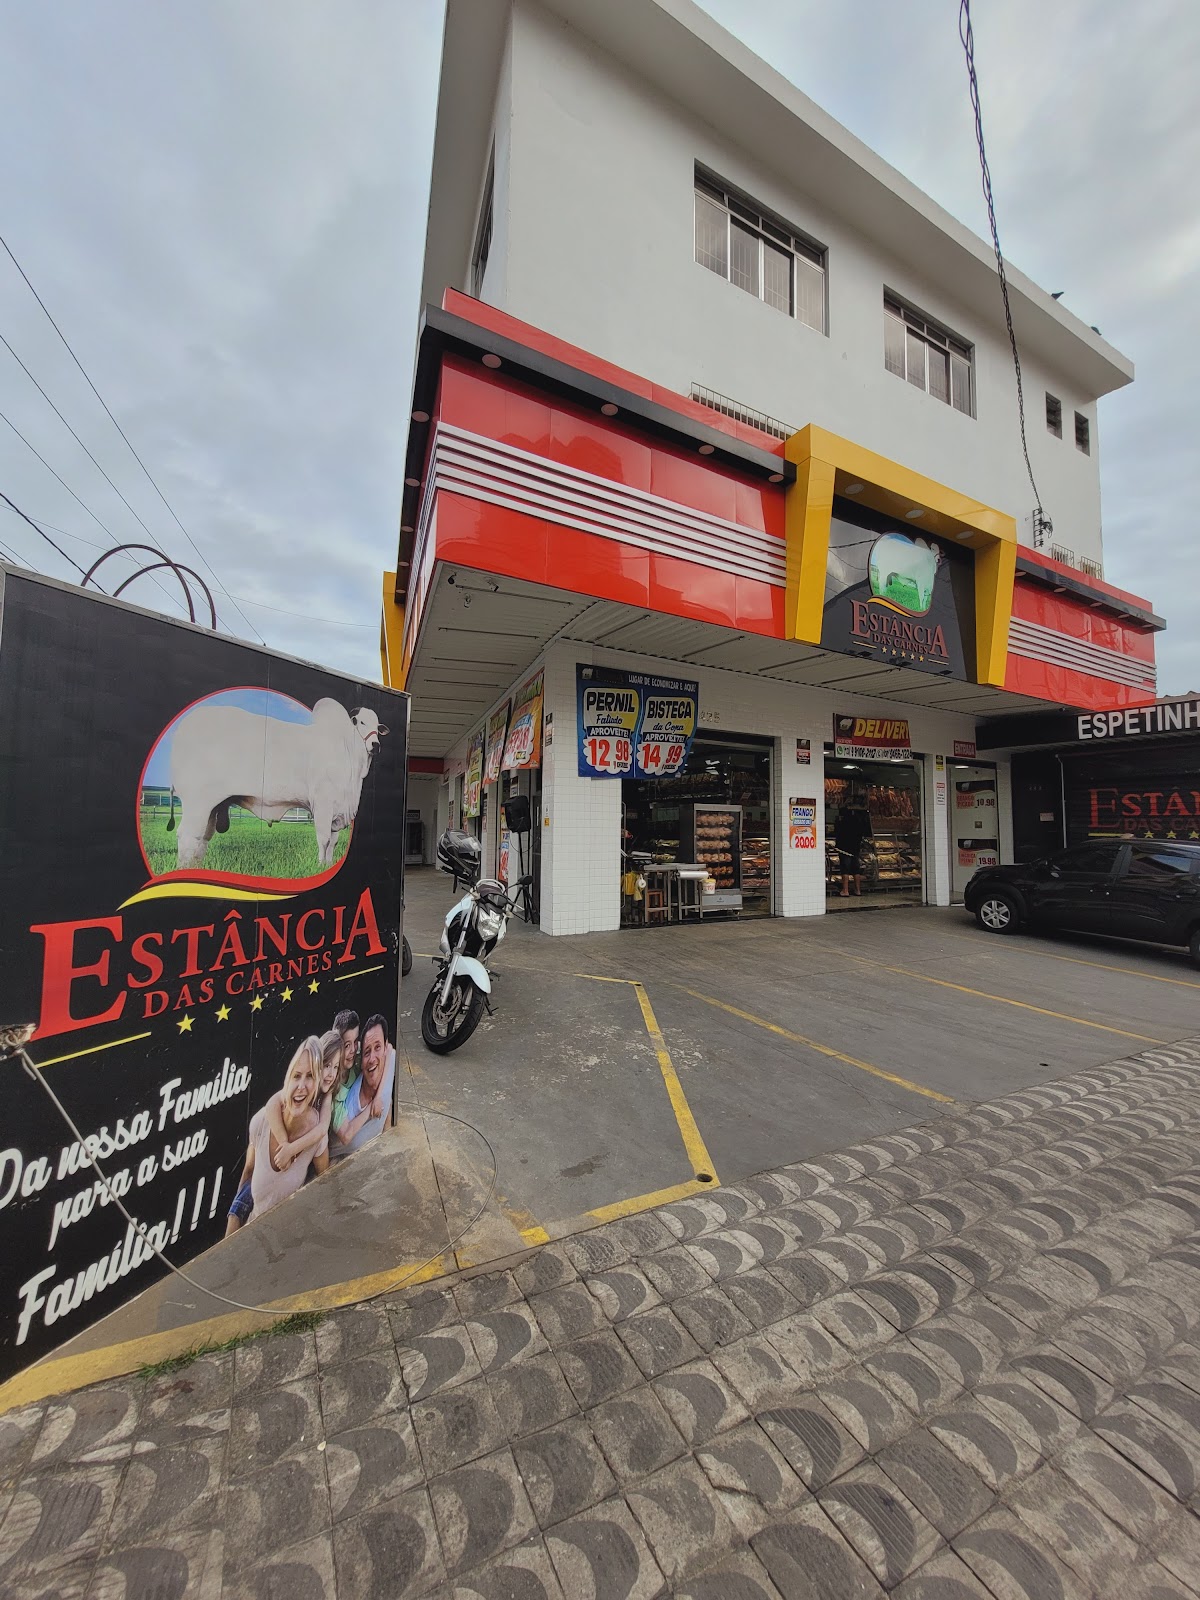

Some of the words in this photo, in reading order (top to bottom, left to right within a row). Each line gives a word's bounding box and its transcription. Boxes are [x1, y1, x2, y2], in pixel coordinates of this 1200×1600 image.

[849, 599, 949, 658] ESTÂNCIA
[873, 633, 892, 646] DAS
[894, 638, 929, 654] CARNES
[628, 674, 643, 685] LUGAR
[644, 677, 651, 686] DE
[651, 678, 679, 690] ECONOMIZAR
[586, 691, 635, 712] PERNIL
[647, 700, 692, 719] BISTECA
[596, 714, 623, 725] Fatiado
[653, 722, 663, 731] da
[664, 722, 684, 734] Copa
[1077, 701, 1200, 739] ESPETINH
[590, 727, 628, 738] APROVEITE!
[645, 733, 685, 743] APROVEITE!
[792, 807, 814, 817] FRANGO
[1123, 818, 1163, 831] DAS
[29, 887, 388, 1041] ESTÂNCIA
[143, 978, 214, 1019] DAS
[226, 950, 333, 995] CARNES
[0, 1148, 52, 1209] Da
[56, 1110, 154, 1186] nossa
[158, 1057, 253, 1132] Família
[47, 1167, 132, 1251] para
[137, 1155, 158, 1188] a
[161, 1129, 208, 1171] sua
